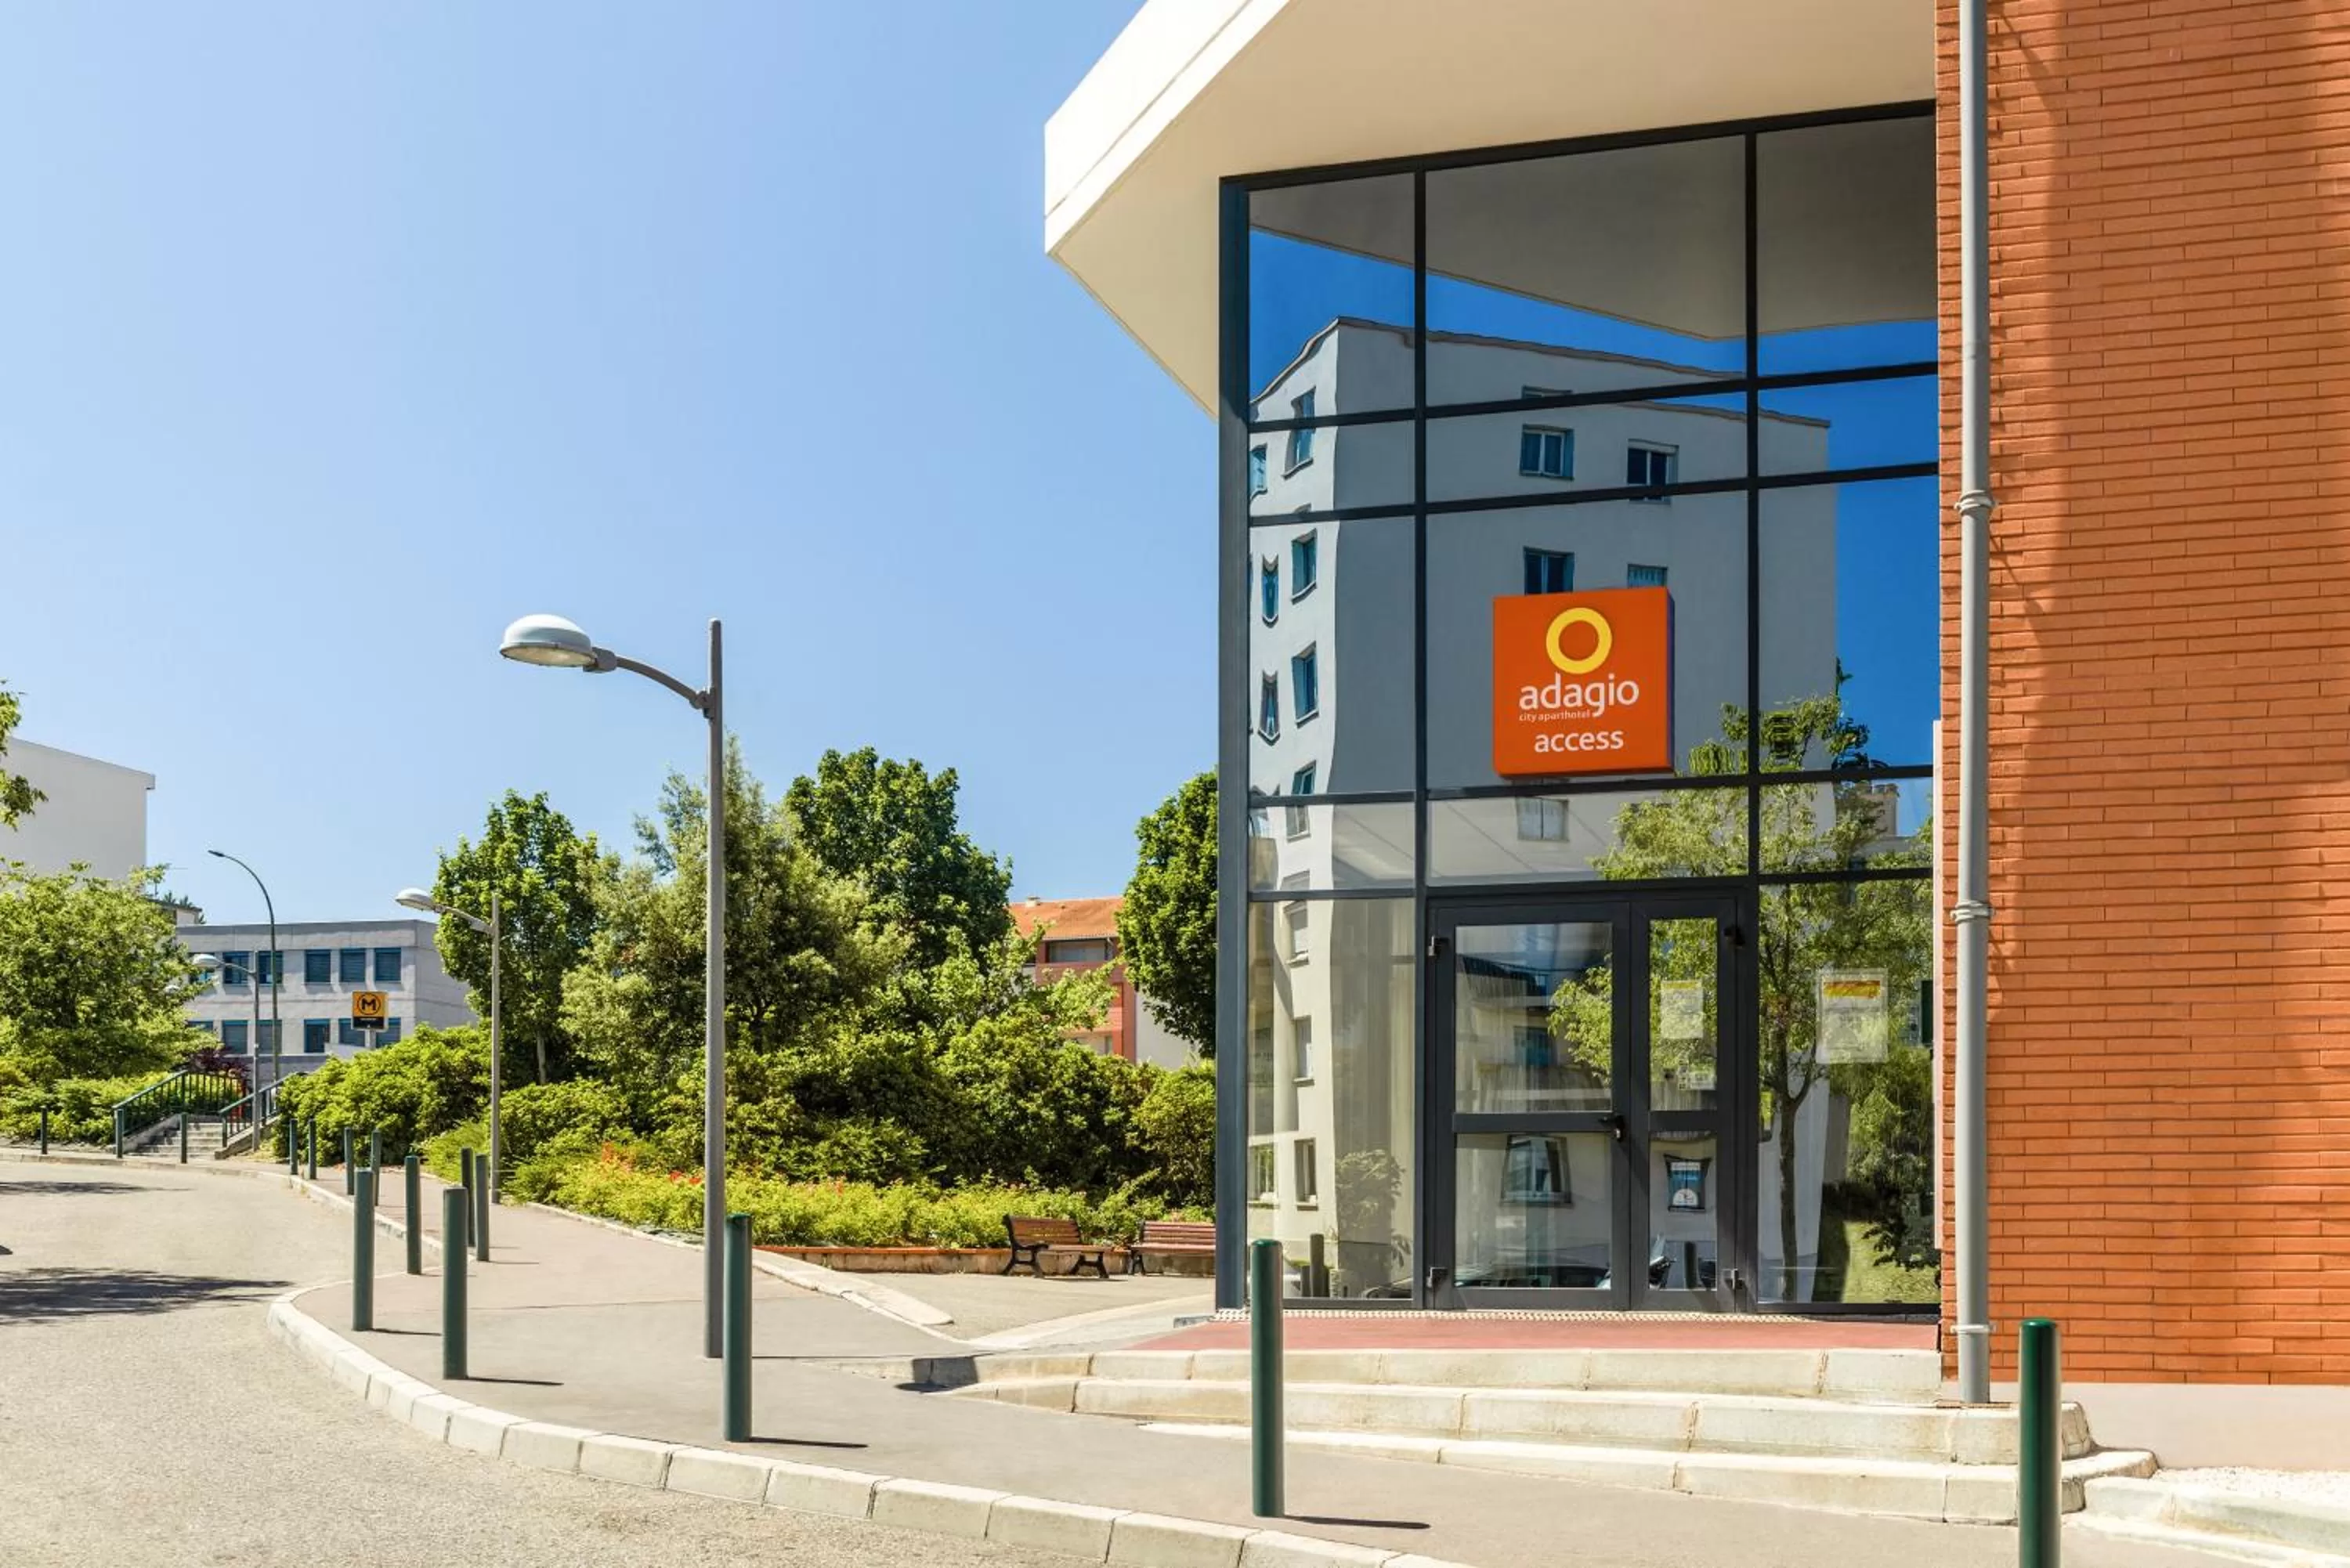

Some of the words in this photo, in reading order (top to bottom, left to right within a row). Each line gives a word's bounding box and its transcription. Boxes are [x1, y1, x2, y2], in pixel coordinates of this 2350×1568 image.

[1519, 671, 1640, 717] adagio
[1519, 714, 1536, 722] city
[1538, 710, 1590, 721] aparthotel
[1534, 730, 1624, 753] access
[361, 998, 377, 1011] M
